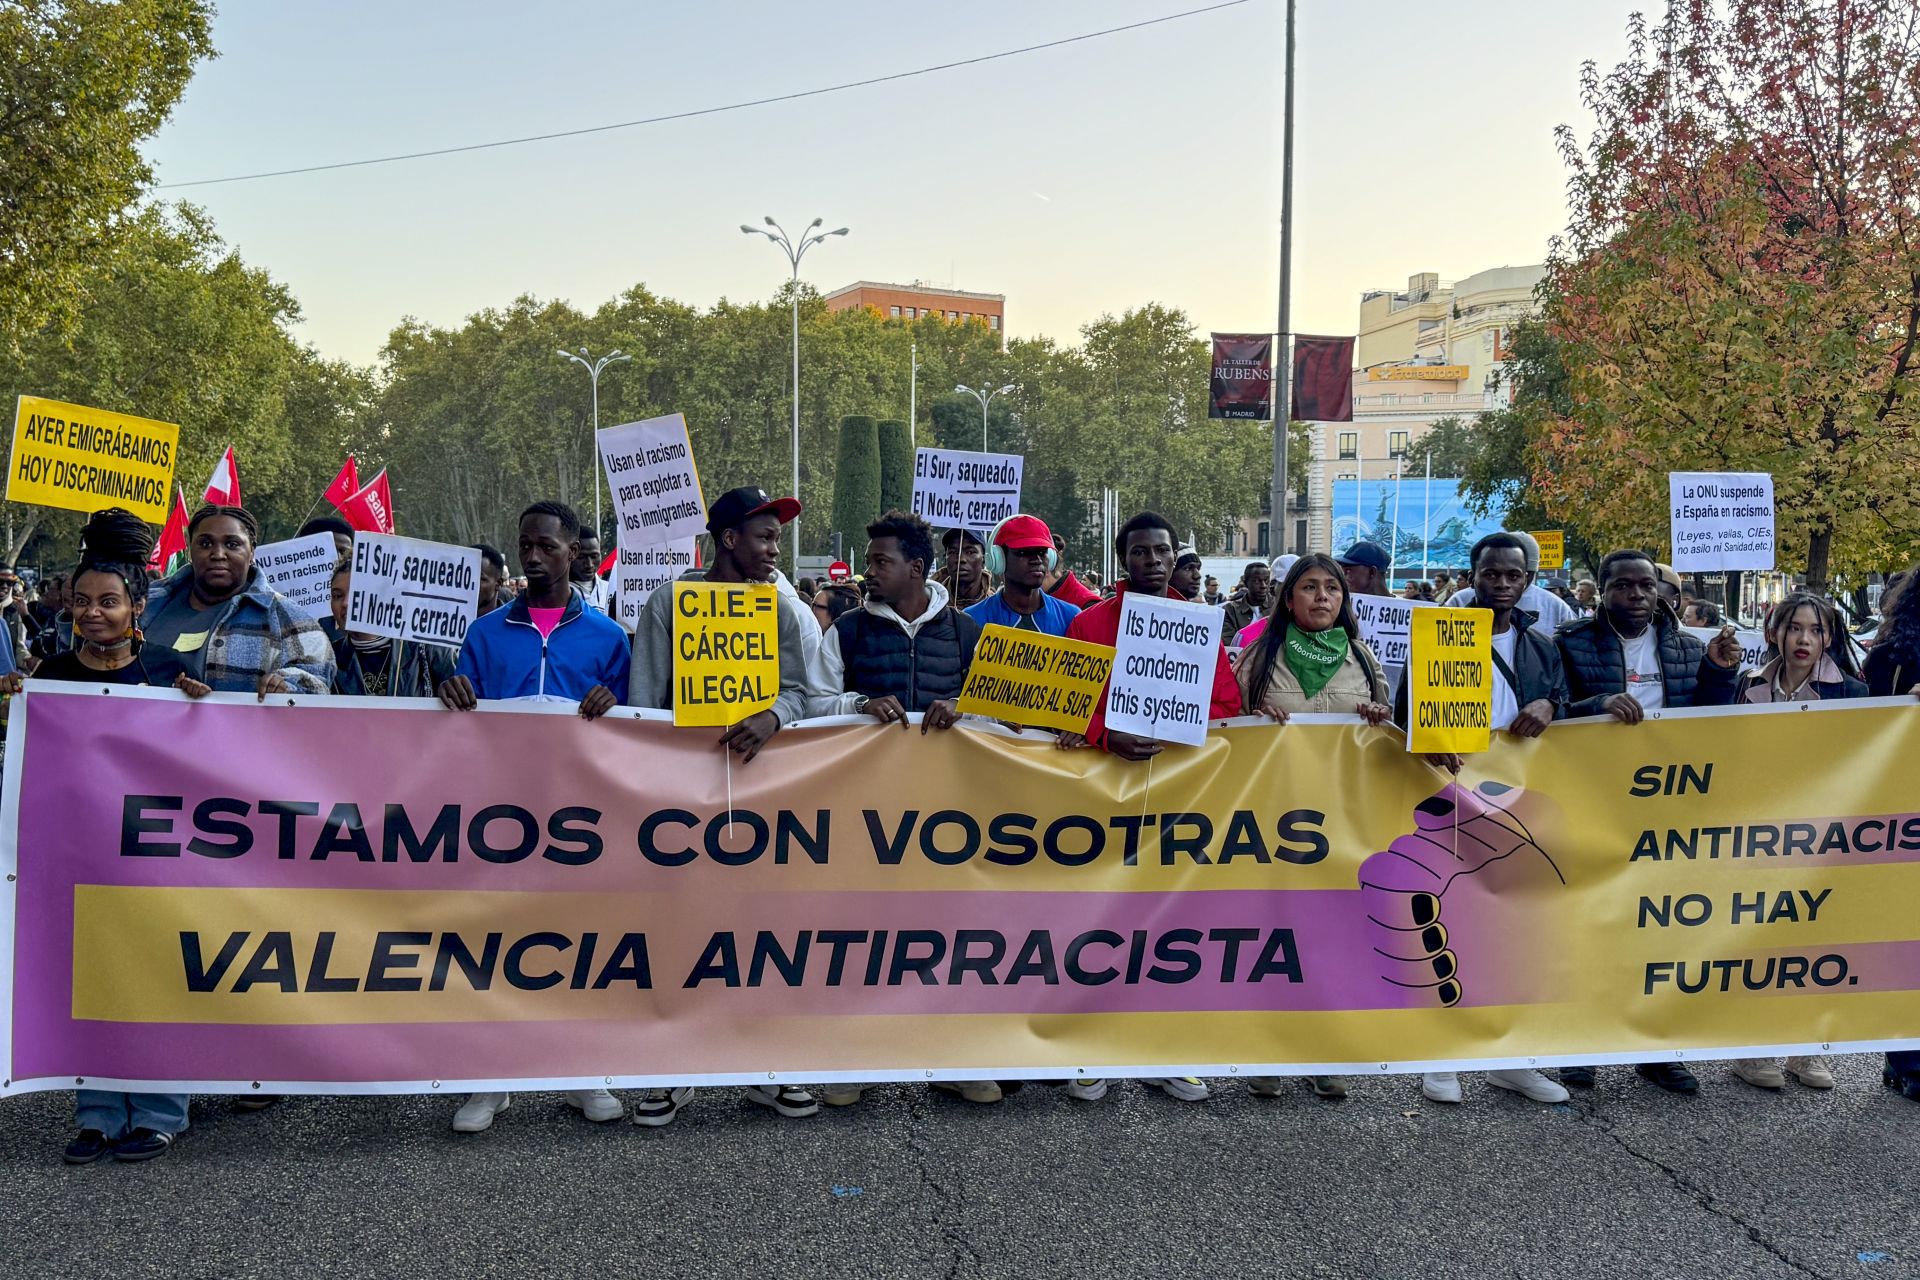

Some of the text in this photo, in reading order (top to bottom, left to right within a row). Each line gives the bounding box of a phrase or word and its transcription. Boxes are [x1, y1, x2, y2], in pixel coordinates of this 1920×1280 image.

[1213, 367, 1270, 381] RUBENS
[25, 414, 172, 473] AYER EMIGRÁBAMOS,
[606, 442, 686, 473] Usan el racismo
[18, 453, 166, 507] HOY DISCRIMINAMOS.
[916, 453, 1019, 488] El Sur, saqueado.
[618, 472, 691, 507] para explotar a
[1683, 484, 1764, 501] La ONU suspende
[622, 499, 701, 531] los inmigrantes.
[913, 491, 924, 515] El
[927, 492, 964, 524] Norte,
[1675, 504, 1772, 521] a España en racismo.
[1677, 527, 1773, 543] (Leyes, vallas, CIEs,
[1677, 546, 1688, 555] no
[1690, 544, 1711, 554] asilo
[1713, 543, 1722, 553] ni
[255, 546, 325, 569] NU suspende
[355, 542, 475, 591] El Sur, saqueado.
[620, 548, 690, 565] Usan el racismo
[278, 572, 290, 582] en
[623, 577, 643, 595] para
[351, 590, 467, 639] El Norte, cerrado
[622, 600, 635, 617] los
[678, 590, 772, 618] C.I.E.=
[1355, 599, 1376, 627] Sur,
[1378, 606, 1411, 630] saque
[680, 625, 774, 661] CÁRCEL
[1125, 609, 1209, 646] Its borders
[1436, 613, 1475, 647] TRÁTESE
[978, 635, 1110, 684] CON ARMAS Y PRECIOS
[1386, 641, 1408, 659] cerr
[1126, 653, 1200, 684] condemn
[1428, 660, 1482, 688] LO NUESTRO
[681, 675, 775, 705] ILEGAL.
[964, 673, 1093, 719] ARRUINAMOS AL SUR.
[1111, 686, 1203, 725] this system.
[1419, 701, 1489, 728] CON NOSOTROS.
[1629, 763, 1713, 797] SIN
[120, 794, 1330, 866] ESTAMOS CON VOSOTRAS
[1629, 818, 1920, 862] ANTIRRACIS
[1637, 889, 1833, 928] NO HAY
[179, 928, 1304, 993] VALENCIA ANTIRRACISTA
[1644, 954, 1858, 995] FUTURO.
